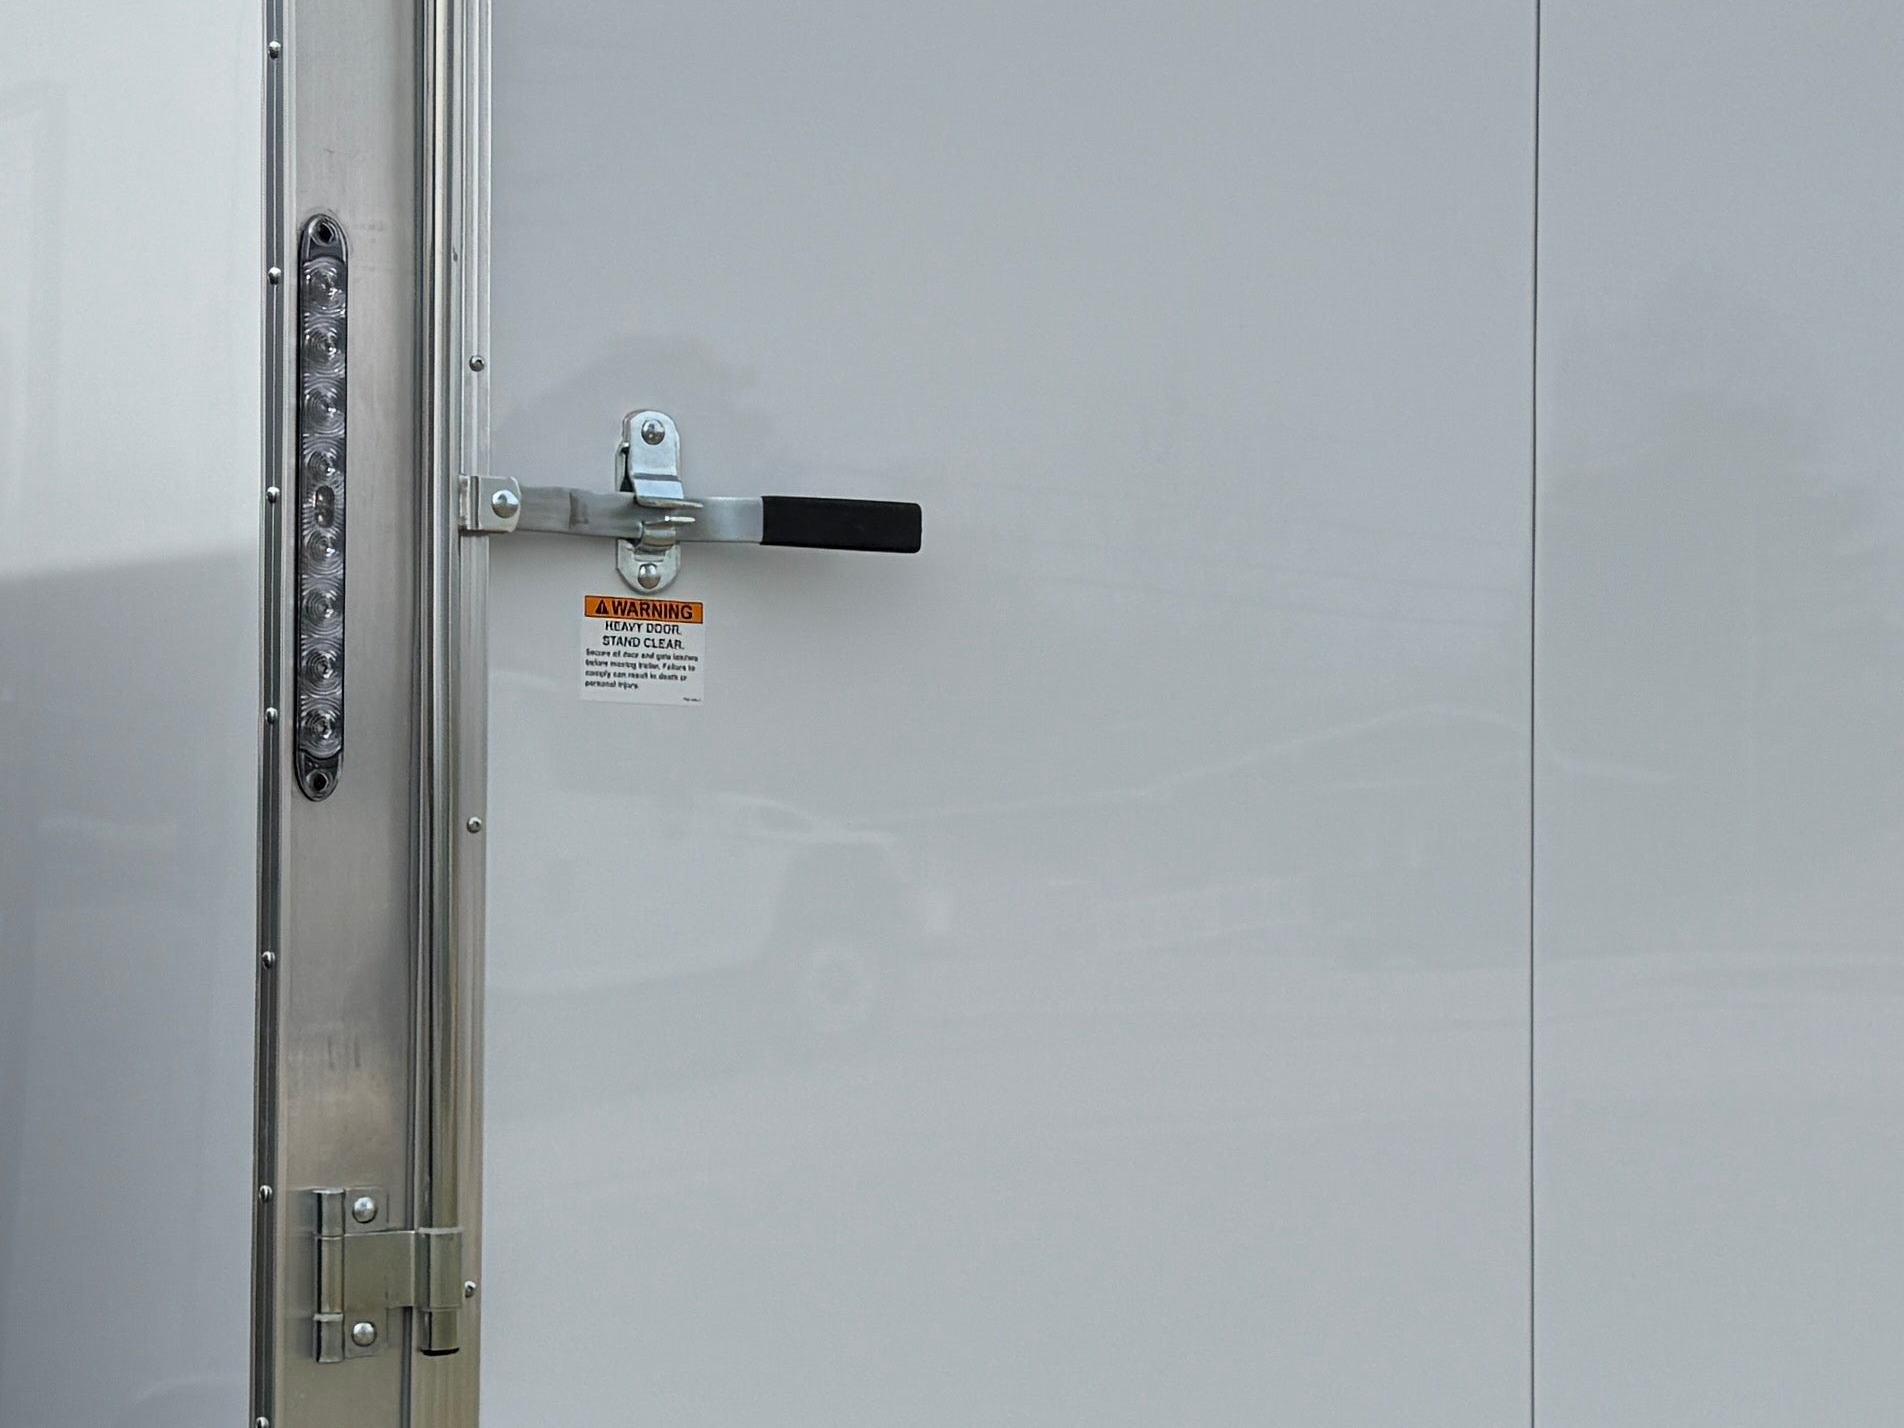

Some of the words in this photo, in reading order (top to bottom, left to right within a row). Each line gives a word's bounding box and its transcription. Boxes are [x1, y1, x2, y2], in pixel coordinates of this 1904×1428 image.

[611, 599, 694, 621] WARNING
[604, 620, 643, 634] HEAVY
[602, 635, 641, 648] STAND
